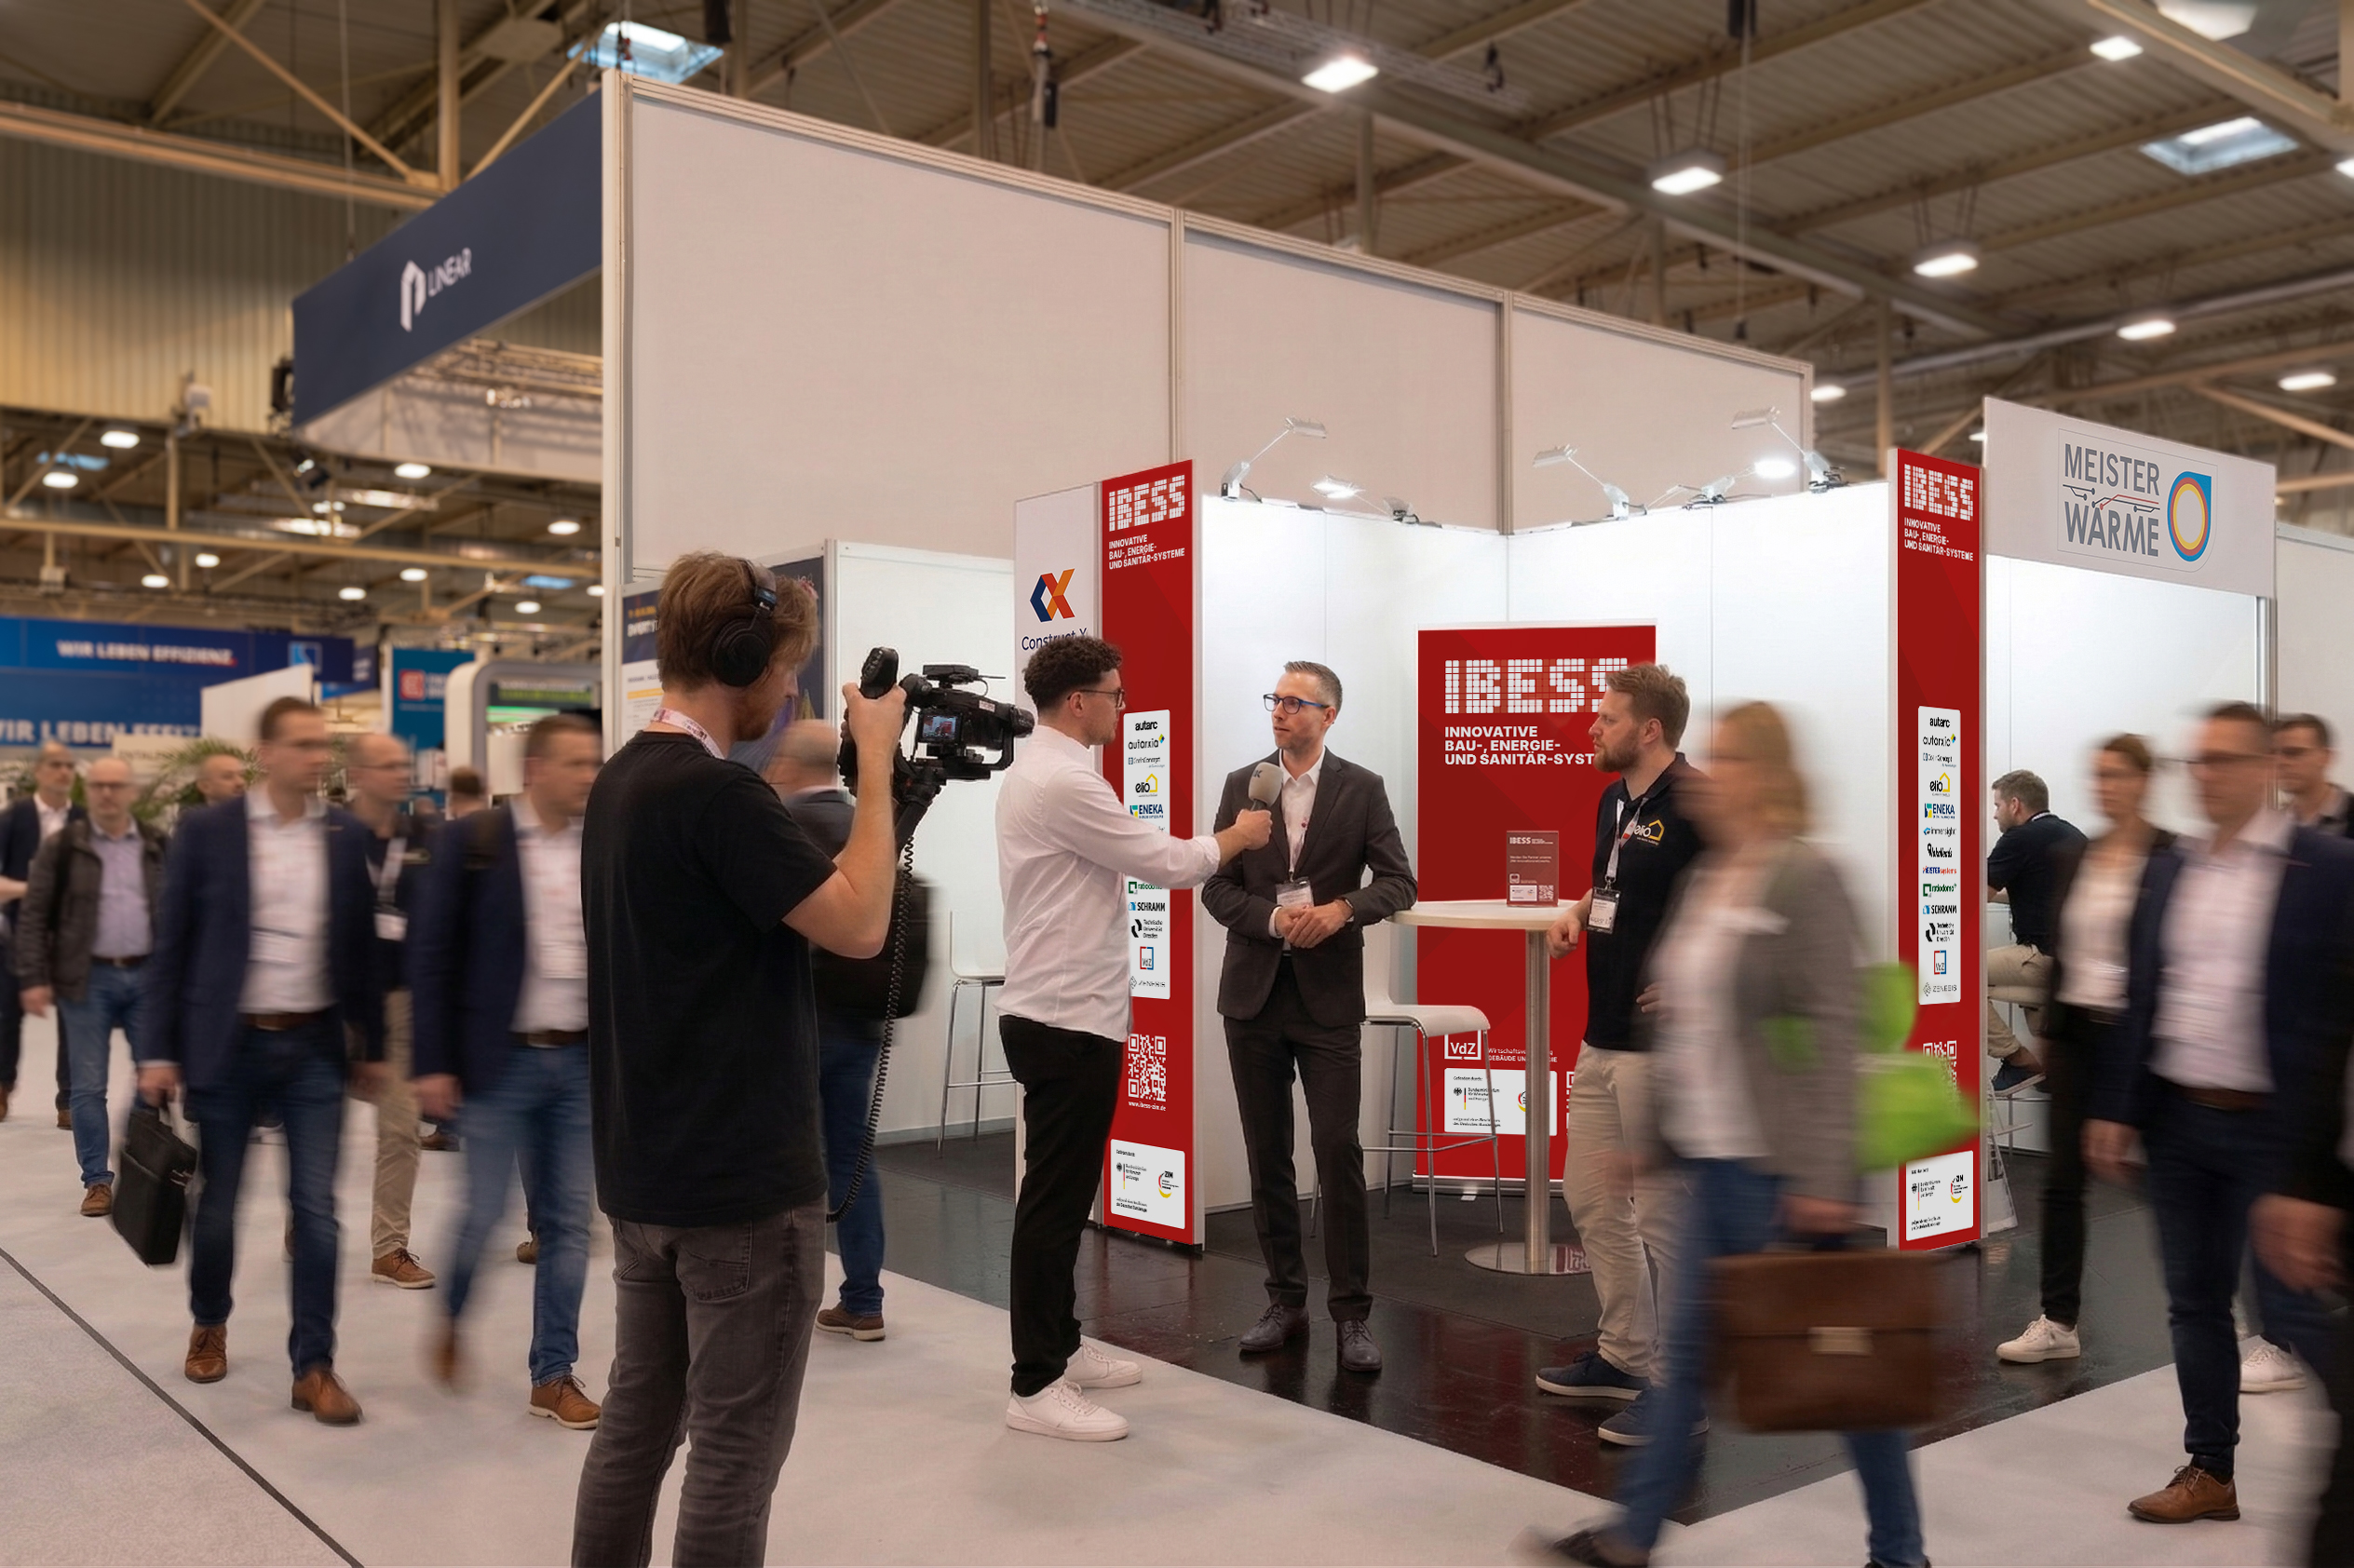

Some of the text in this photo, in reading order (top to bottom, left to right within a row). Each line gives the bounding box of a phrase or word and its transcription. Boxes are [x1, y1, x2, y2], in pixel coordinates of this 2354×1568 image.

[2064, 443, 2160, 496] MEISTER
[1904, 464, 1973, 521] IBESS
[1108, 474, 1185, 532] IBESS
[1904, 517, 1941, 534] INNOVATIVE
[1108, 534, 1148, 549] INNOVATIVE
[1904, 528, 1950, 546] BAU-, ENERGIE-
[1108, 543, 1157, 560] BAU-, ENERGIE-
[1904, 539, 1974, 561] UND SANITÄR-SYSTEME
[1108, 547, 1185, 570] UND SANITÄR-SYSTEME
[1135, 721, 1158, 731] autarc
[1929, 717, 1951, 728] autarc
[0, 719, 35, 743] IR
[1445, 726, 1538, 737] INNOVATIVE
[1445, 739, 1561, 754] BAU-, ENERGIE-
[1445, 750, 1595, 764] UND SANITÄR-SYST
[1138, 804, 1164, 815] ENEKA
[1932, 803, 1955, 815] ENEKA
[1137, 901, 1166, 912] SCHRAMM
[1931, 904, 1957, 914] SCHRAMM
[1450, 1042, 1476, 1055] VdZ
